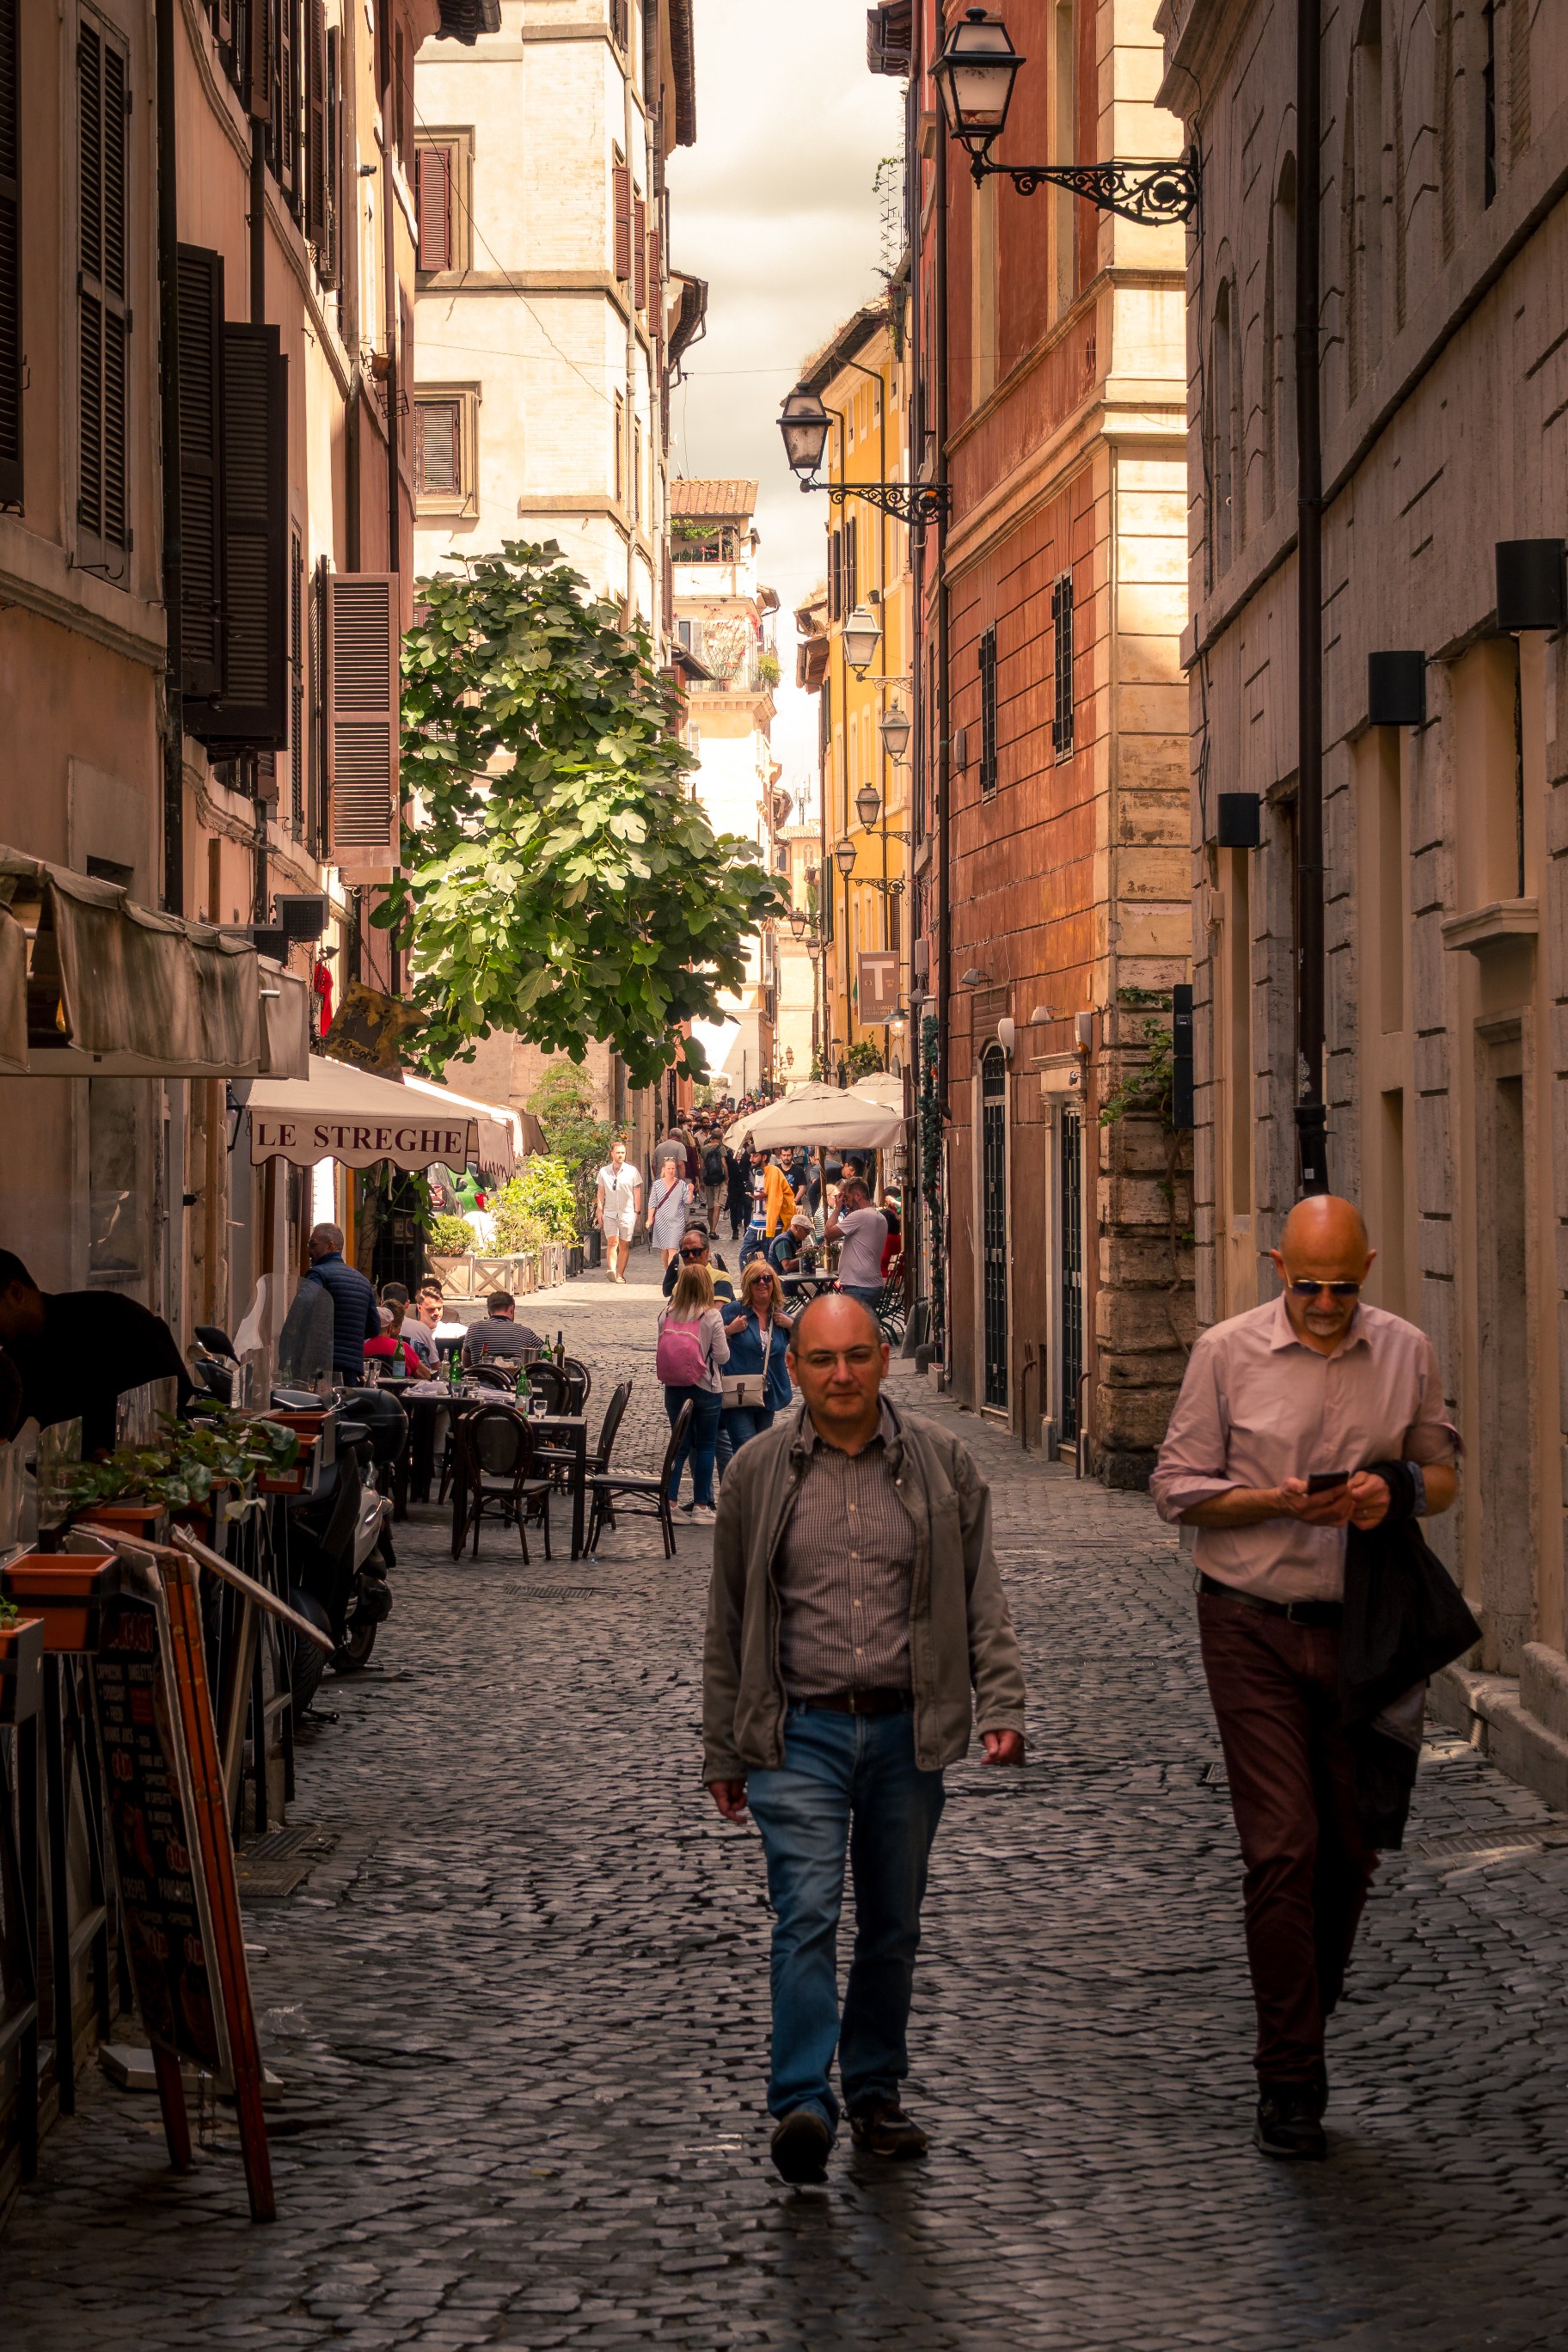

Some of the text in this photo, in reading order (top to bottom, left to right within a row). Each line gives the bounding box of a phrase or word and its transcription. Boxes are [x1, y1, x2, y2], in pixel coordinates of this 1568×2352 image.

[861, 960, 895, 1001] T
[256, 1124, 462, 1155] LE STREGHE
